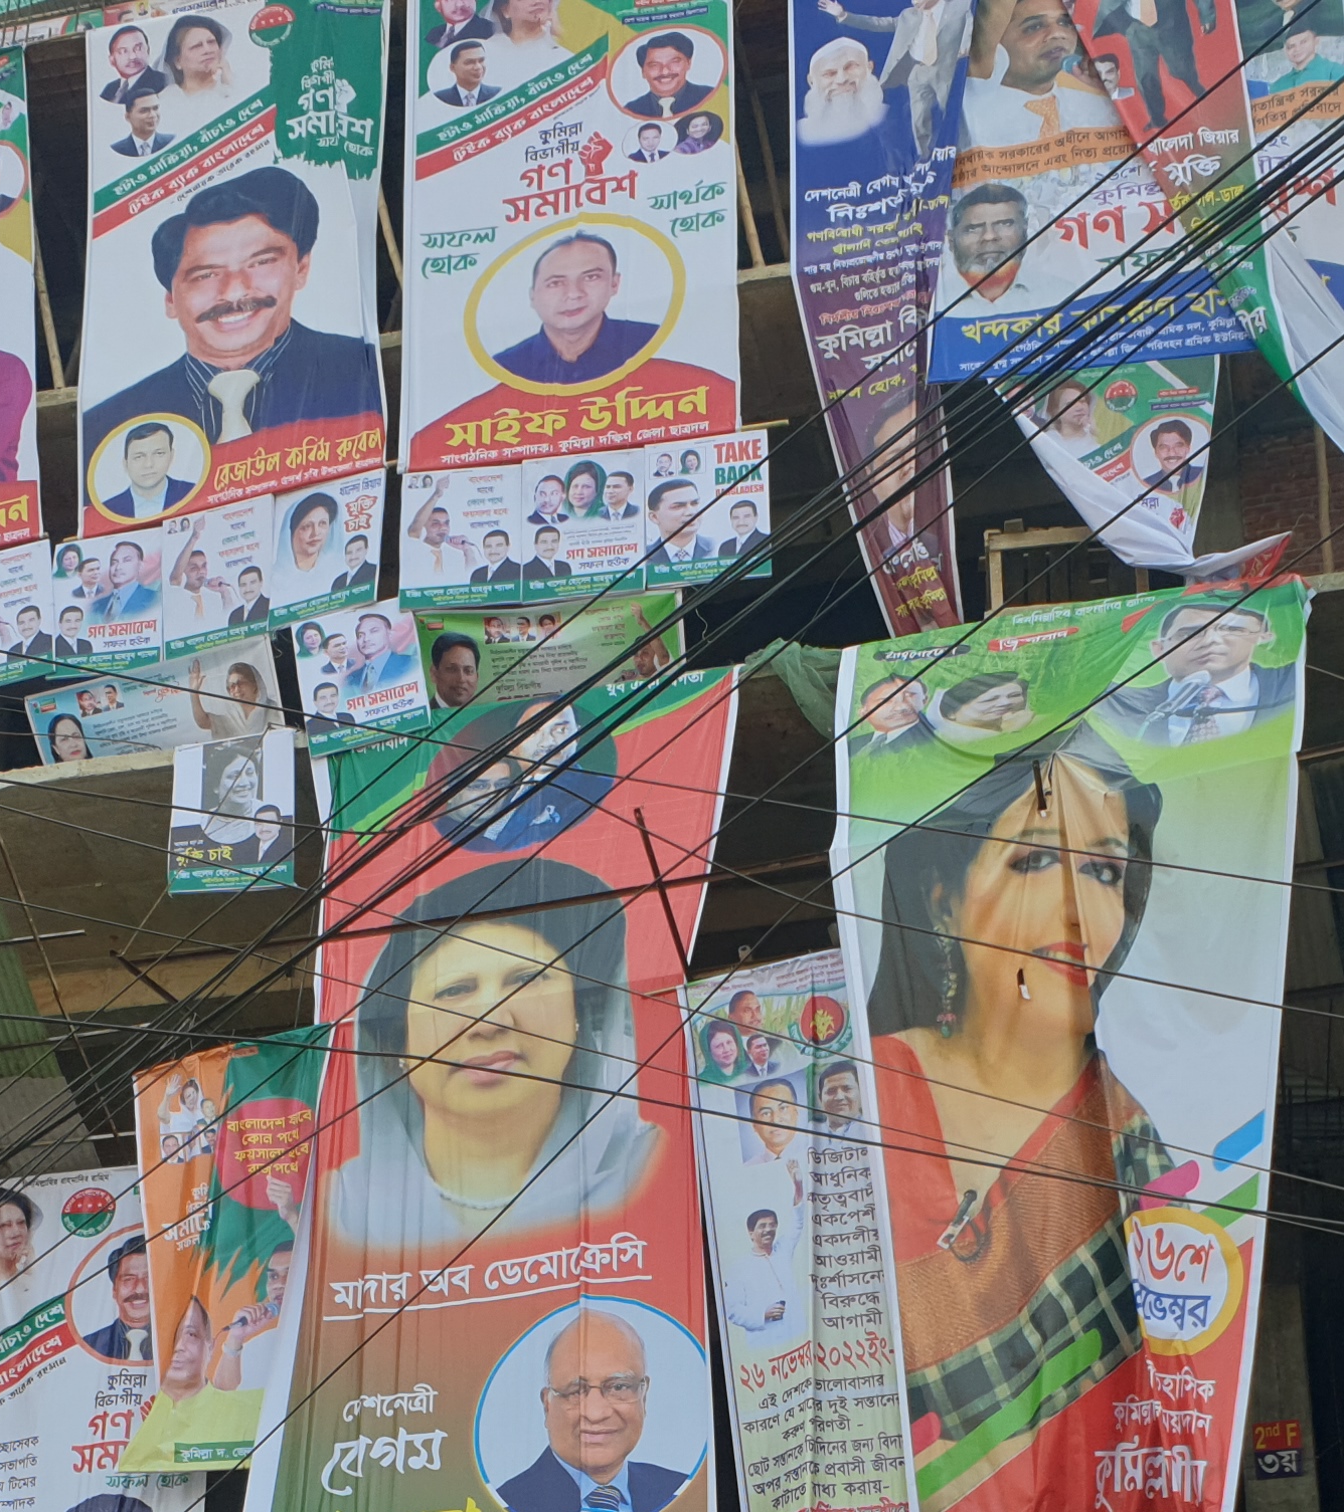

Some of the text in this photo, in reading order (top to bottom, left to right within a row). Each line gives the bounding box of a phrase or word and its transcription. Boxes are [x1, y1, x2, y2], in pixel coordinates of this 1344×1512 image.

[539, 121, 583, 144] কুমিল্লা
[520, 158, 572, 190] গণ
[503, 170, 638, 224] সমাবেশ
[421, 226, 498, 249] সফল
[670, 209, 727, 238] হোক
[421, 253, 479, 279] হোক
[446, 386, 709, 447] সাইফ উদ্দিন
[212, 449, 283, 491] রেজাউল
[286, 437, 331, 468] করিম
[335, 428, 383, 463] রুবেল
[715, 439, 762, 464] TAKE
[715, 463, 762, 485] BACK
[330, 1231, 648, 1310] মাদার অব ডেমোক্রেসি
[1253, 1420, 1298, 1449] 2nd F
[321, 1426, 447, 1496] বেগম
